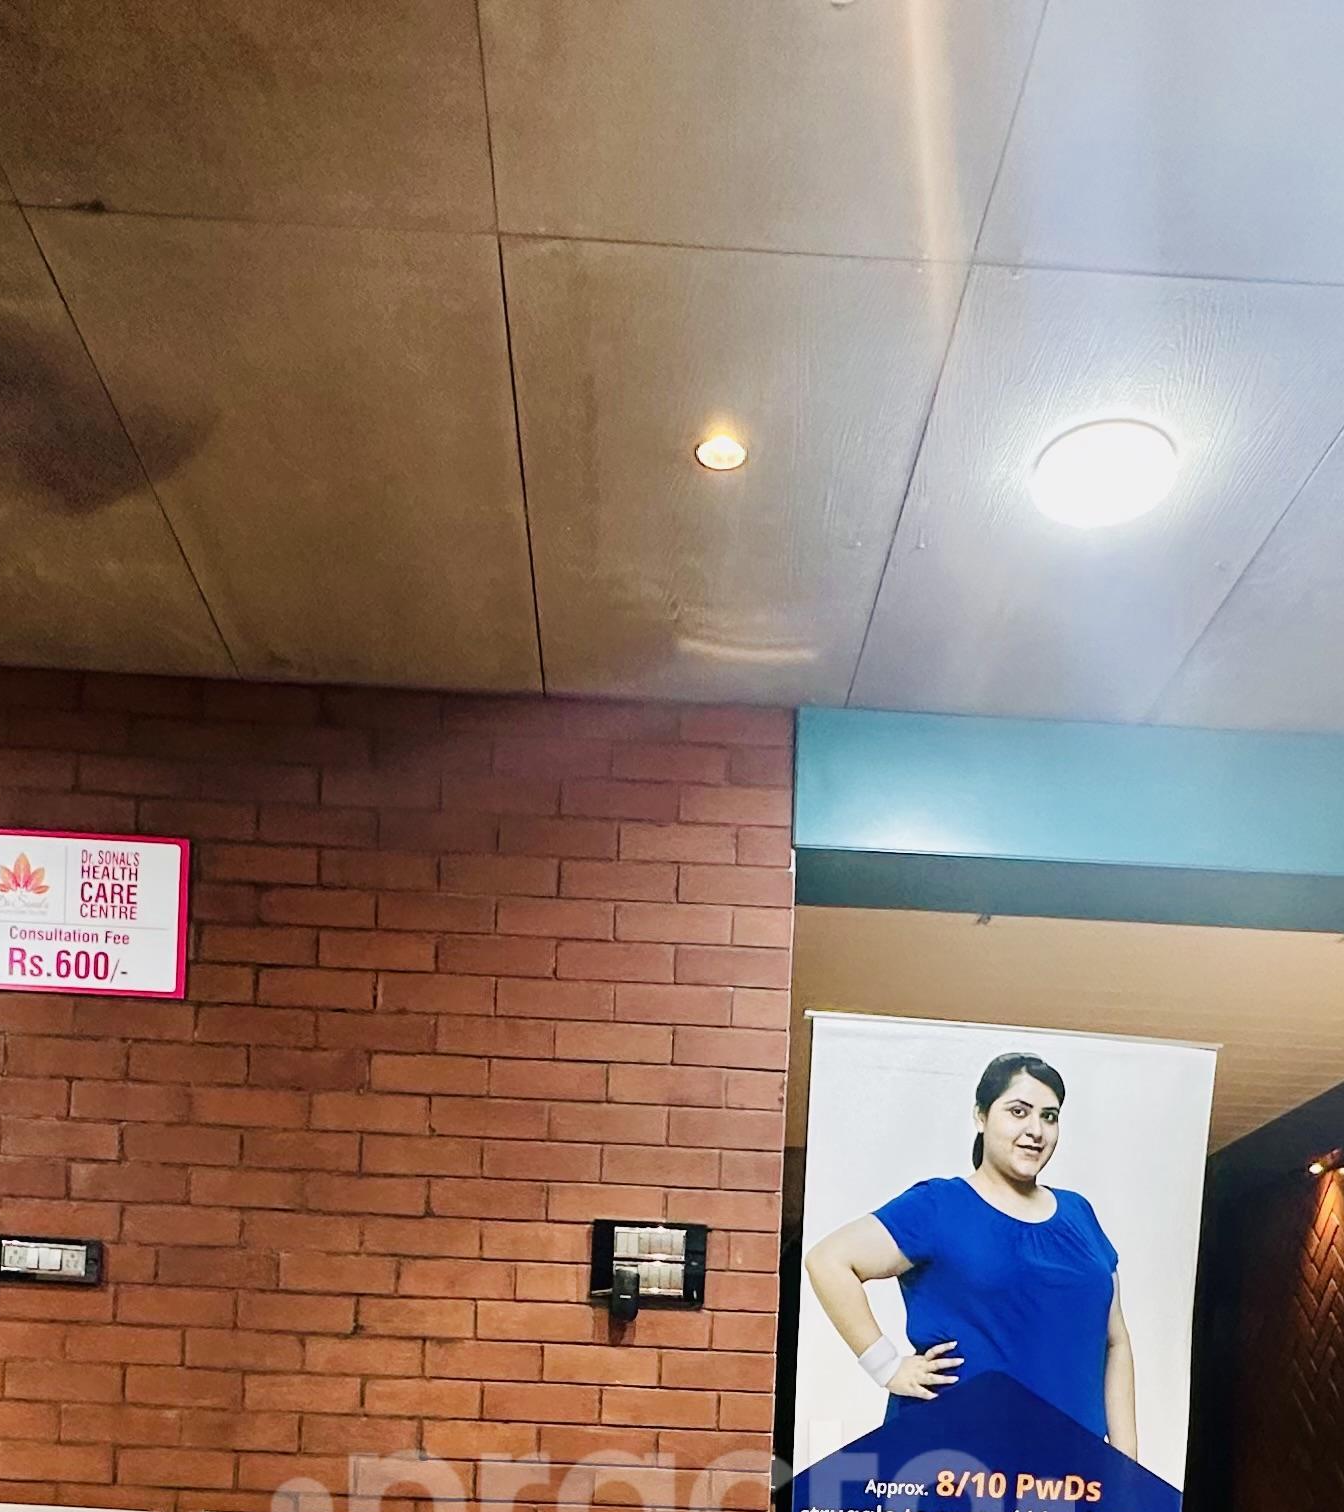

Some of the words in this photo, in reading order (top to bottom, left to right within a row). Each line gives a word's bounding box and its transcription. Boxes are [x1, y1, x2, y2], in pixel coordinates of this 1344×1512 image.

[98, 850, 140, 867] SONAL'S
[81, 865, 138, 882] HEALTH
[80, 881, 138, 905] CARE
[80, 903, 138, 920] CENTRE
[9, 925, 99, 944] Consultation
[104, 930, 130, 945] Fee
[8, 947, 128, 983] Rs.600/-
[864, 1478, 929, 1498] Approx.
[936, 1470, 1007, 1499] 8/10
[1015, 1474, 1102, 1502] PwDs
